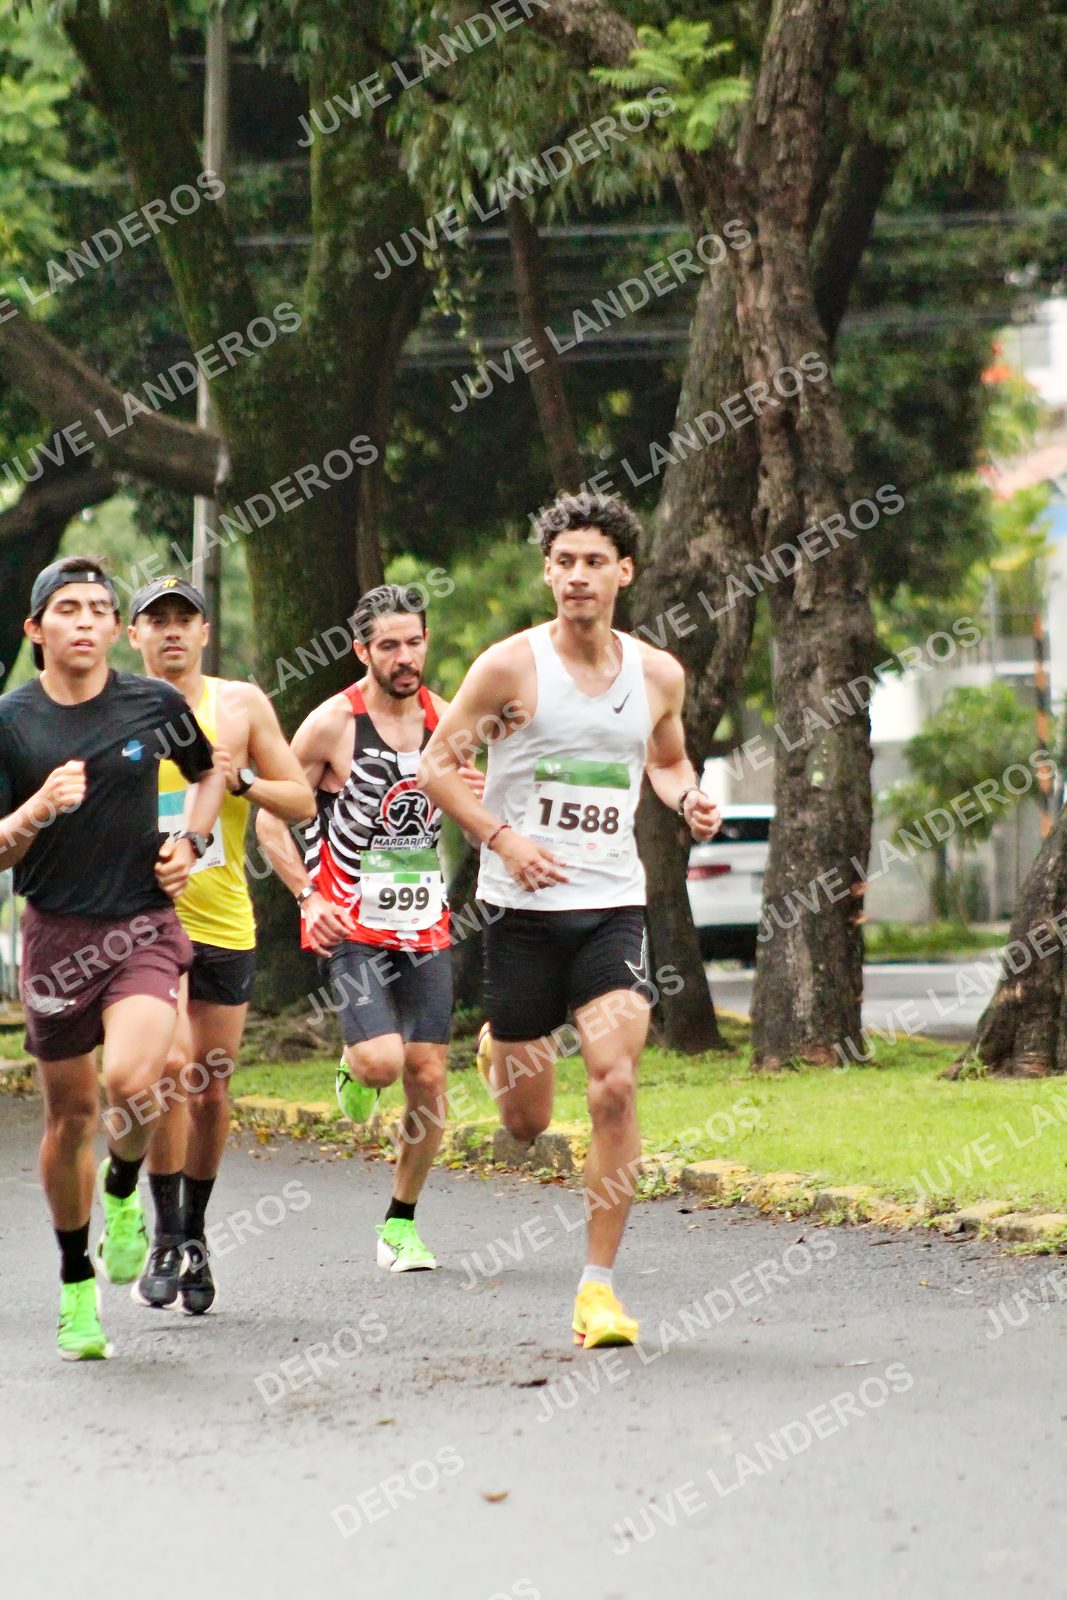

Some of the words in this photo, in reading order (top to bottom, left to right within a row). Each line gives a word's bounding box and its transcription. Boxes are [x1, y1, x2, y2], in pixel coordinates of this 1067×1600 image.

[539, 798, 619, 835] 1588
[374, 836, 433, 846] MARGARITO
[378, 887, 429, 911] 999
